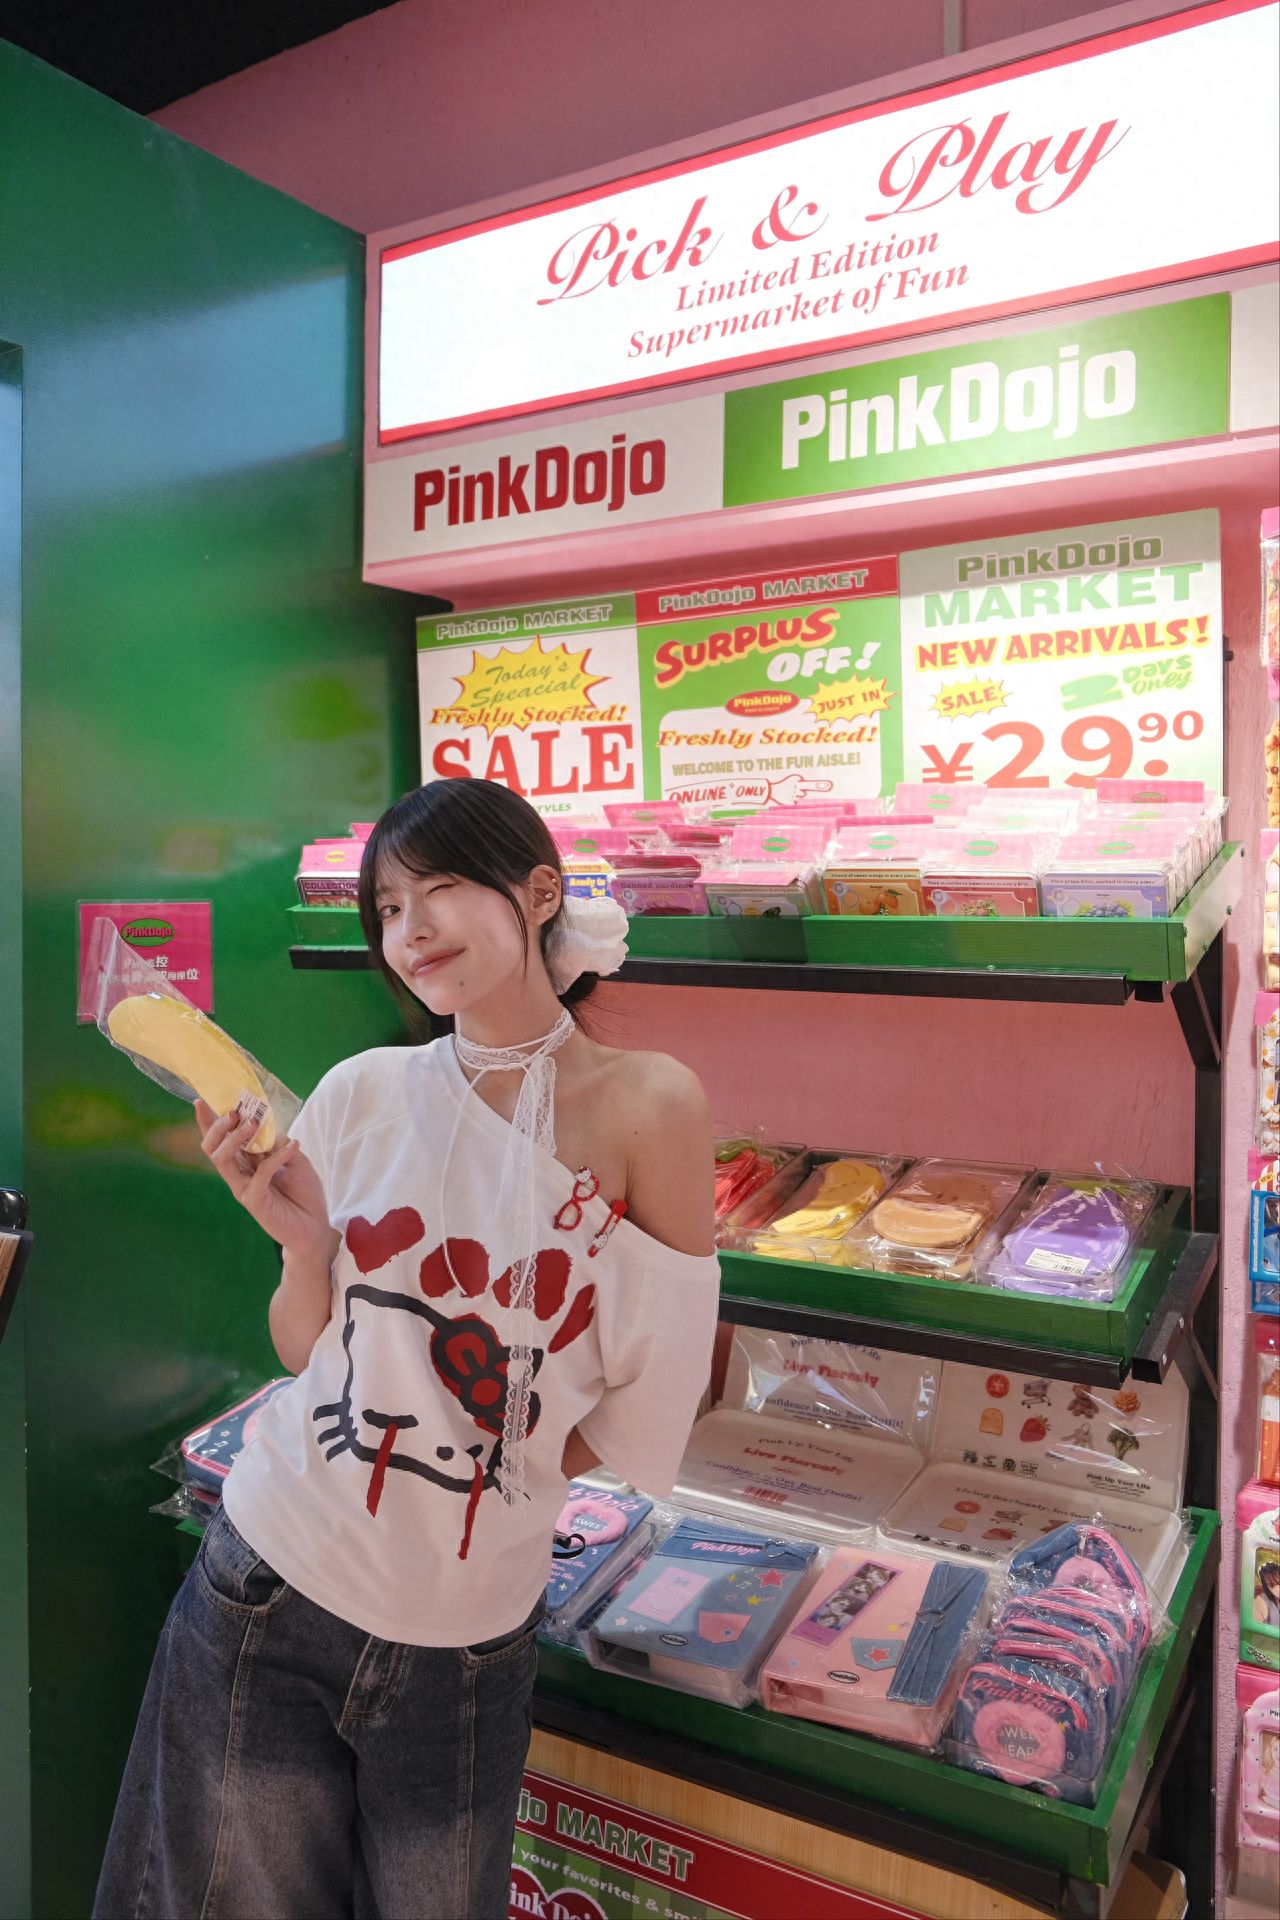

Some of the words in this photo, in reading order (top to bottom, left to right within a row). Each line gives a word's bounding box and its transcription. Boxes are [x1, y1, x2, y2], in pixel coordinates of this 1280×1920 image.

[537, 193, 722, 306] Pick
[752, 185, 827, 250] &
[865, 111, 1132, 221] Play
[676, 259, 800, 311] Limited
[809, 232, 940, 280] Edition
[627, 291, 842, 358] Supermarket
[853, 281, 887, 316] of
[890, 262, 970, 301] Fun
[782, 343, 1137, 471] PinkDojo
[414, 434, 666, 534] PinkDojo
[957, 536, 1164, 583] PinkDojo
[659, 586, 755, 612] PinkDojo
[763, 569, 868, 599] MARKET
[924, 563, 1203, 628] MARKET
[436, 617, 518, 640] PinkDojo
[524, 604, 613, 630] MARKET
[916, 637, 997, 671] NEW
[1005, 616, 1210, 662] ARRIVALS!
[654, 608, 841, 689] SURPLUS
[766, 642, 881, 682] OFF!
[471, 674, 581, 709] Speacial
[485, 656, 569, 685] Today's
[733, 695, 792, 707] PinkDojo
[818, 695, 854, 714] JUST
[862, 688, 881, 703] IN
[941, 686, 998, 711] SALE
[1060, 675, 1124, 711] 2
[430, 706, 514, 726] Freshly
[520, 704, 628, 724] Stocked!
[657, 728, 754, 748] Freshly
[759, 726, 877, 745] Stocked!
[432, 724, 635, 796] SALE
[672, 762, 733, 777] WELCOME
[736, 759, 754, 772] TO
[757, 757, 783, 771] THE
[786, 755, 813, 769] FUN
[817, 751, 861, 767] AISLE!
[669, 786, 727, 803] ONLINE
[556, 1802, 696, 1882] MARKET
[521, 1848, 559, 1870] your
[562, 1864, 641, 1905] favorites
[645, 1898, 659, 1912] &
